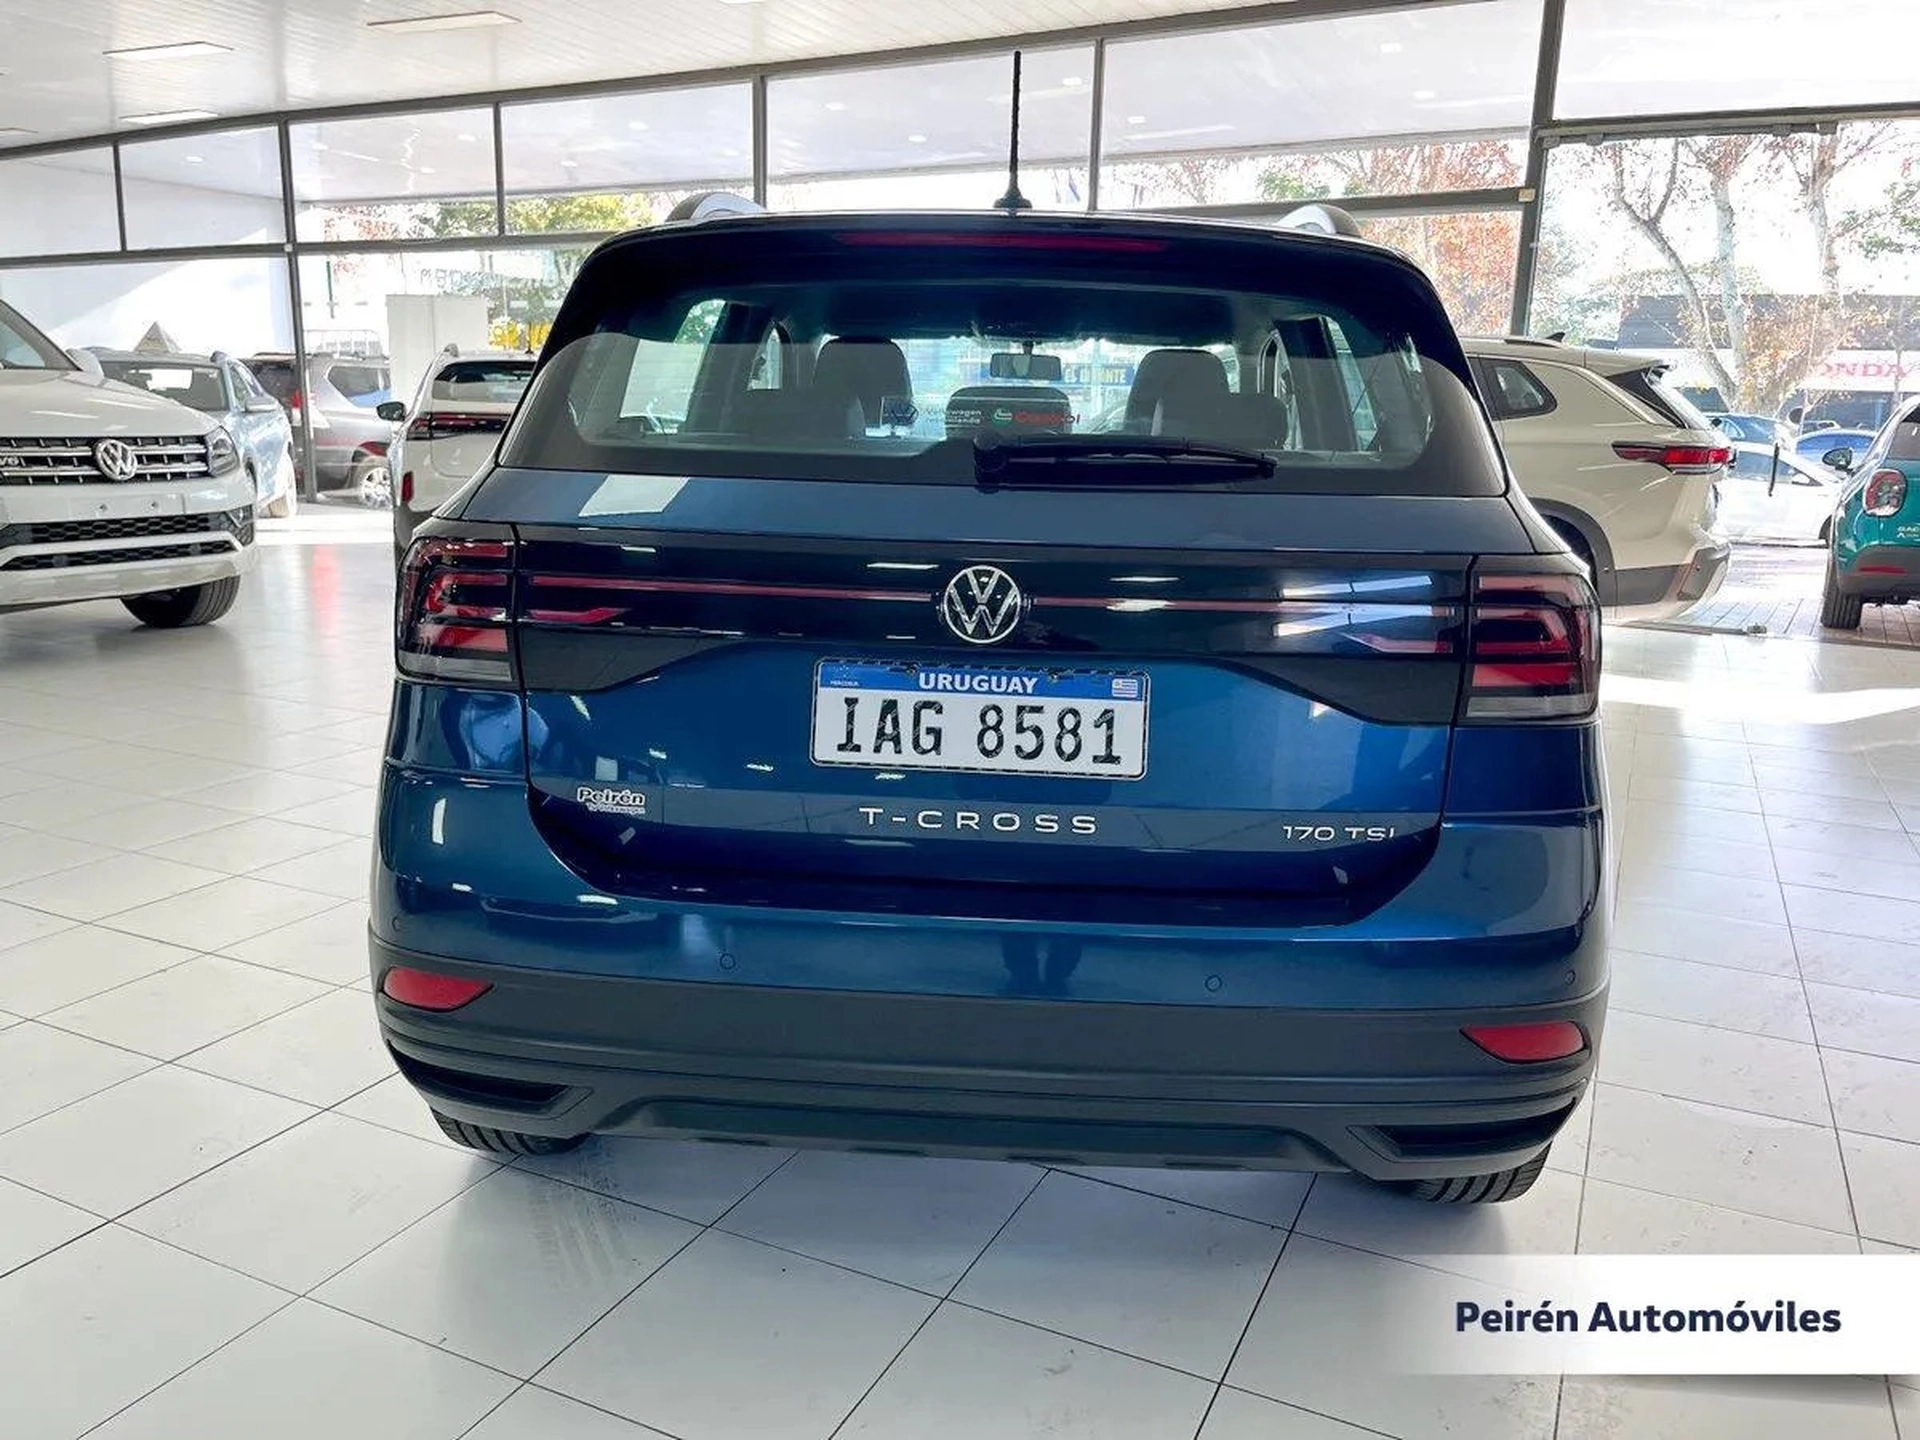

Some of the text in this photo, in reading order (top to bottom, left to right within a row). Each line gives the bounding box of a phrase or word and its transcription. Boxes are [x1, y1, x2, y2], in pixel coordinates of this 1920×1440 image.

[919, 672, 1038, 694] URUGUAY
[837, 697, 1121, 765] IAG 8581
[577, 786, 646, 806] Peirén
[858, 807, 1097, 834] T-CROSS
[1282, 826, 1395, 841] 170 TSI
